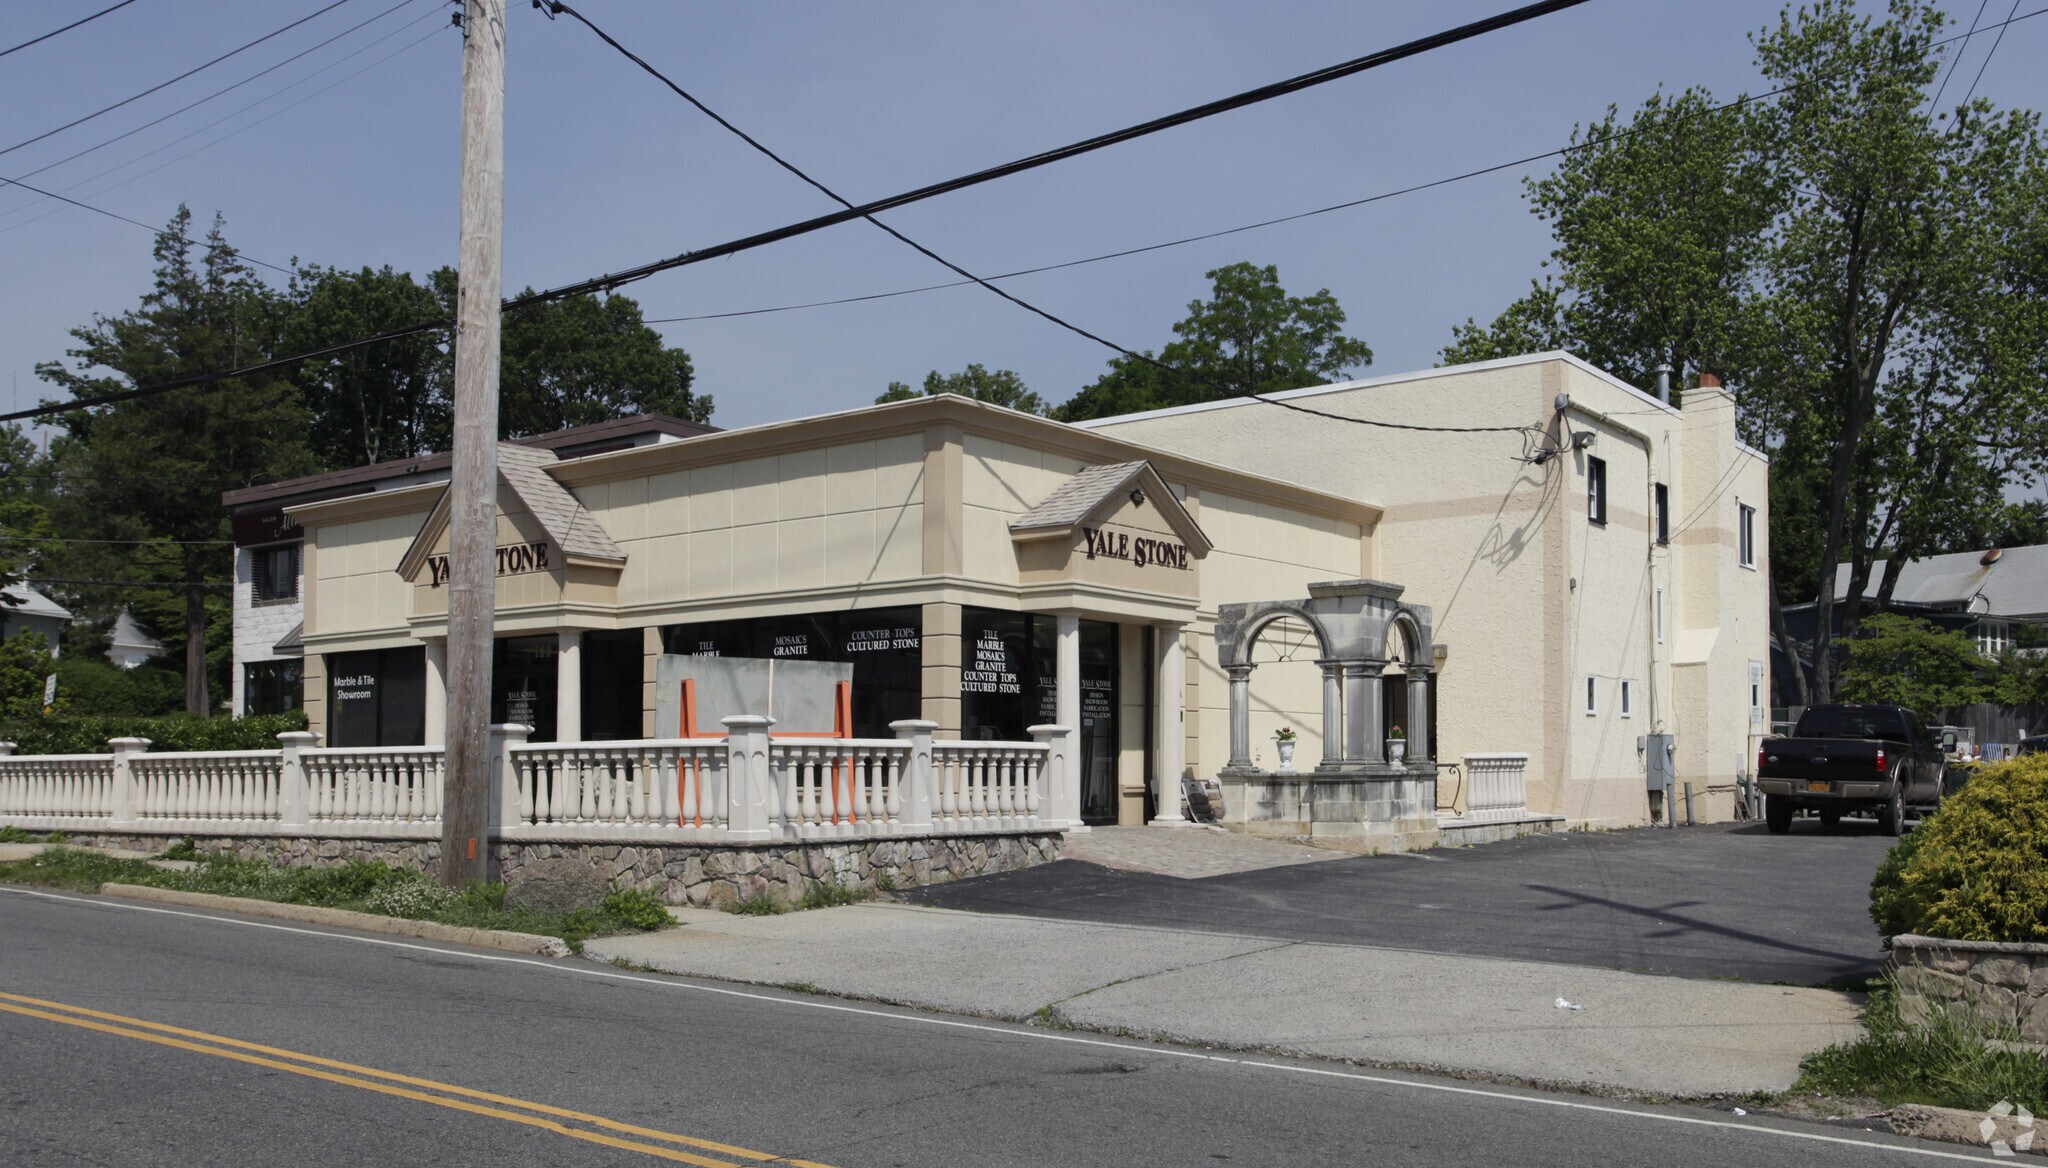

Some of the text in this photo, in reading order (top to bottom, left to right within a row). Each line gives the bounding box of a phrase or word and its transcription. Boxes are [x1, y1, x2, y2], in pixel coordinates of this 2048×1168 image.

[1083, 527, 1188, 569] YALE STONE
[428, 542, 548, 588] YA TONE
[851, 628, 915, 641] COUNTER TOPS
[983, 629, 998, 640] TILE
[699, 641, 714, 651] TILE
[775, 635, 807, 646] MOSAICS
[847, 638, 919, 652] CULTURED STONE
[976, 640, 1005, 651] MARBLE
[773, 645, 808, 656] GRANITE
[976, 650, 1005, 661] MOSAICS
[975, 661, 1006, 672] GRANITE
[334, 675, 374, 687] Marble & Tile
[964, 671, 1017, 683] COUNTER TOPS
[960, 681, 1021, 694] CULTURED STONE
[1082, 679, 1111, 690] YALE STONE
[337, 690, 371, 700] Showroom
